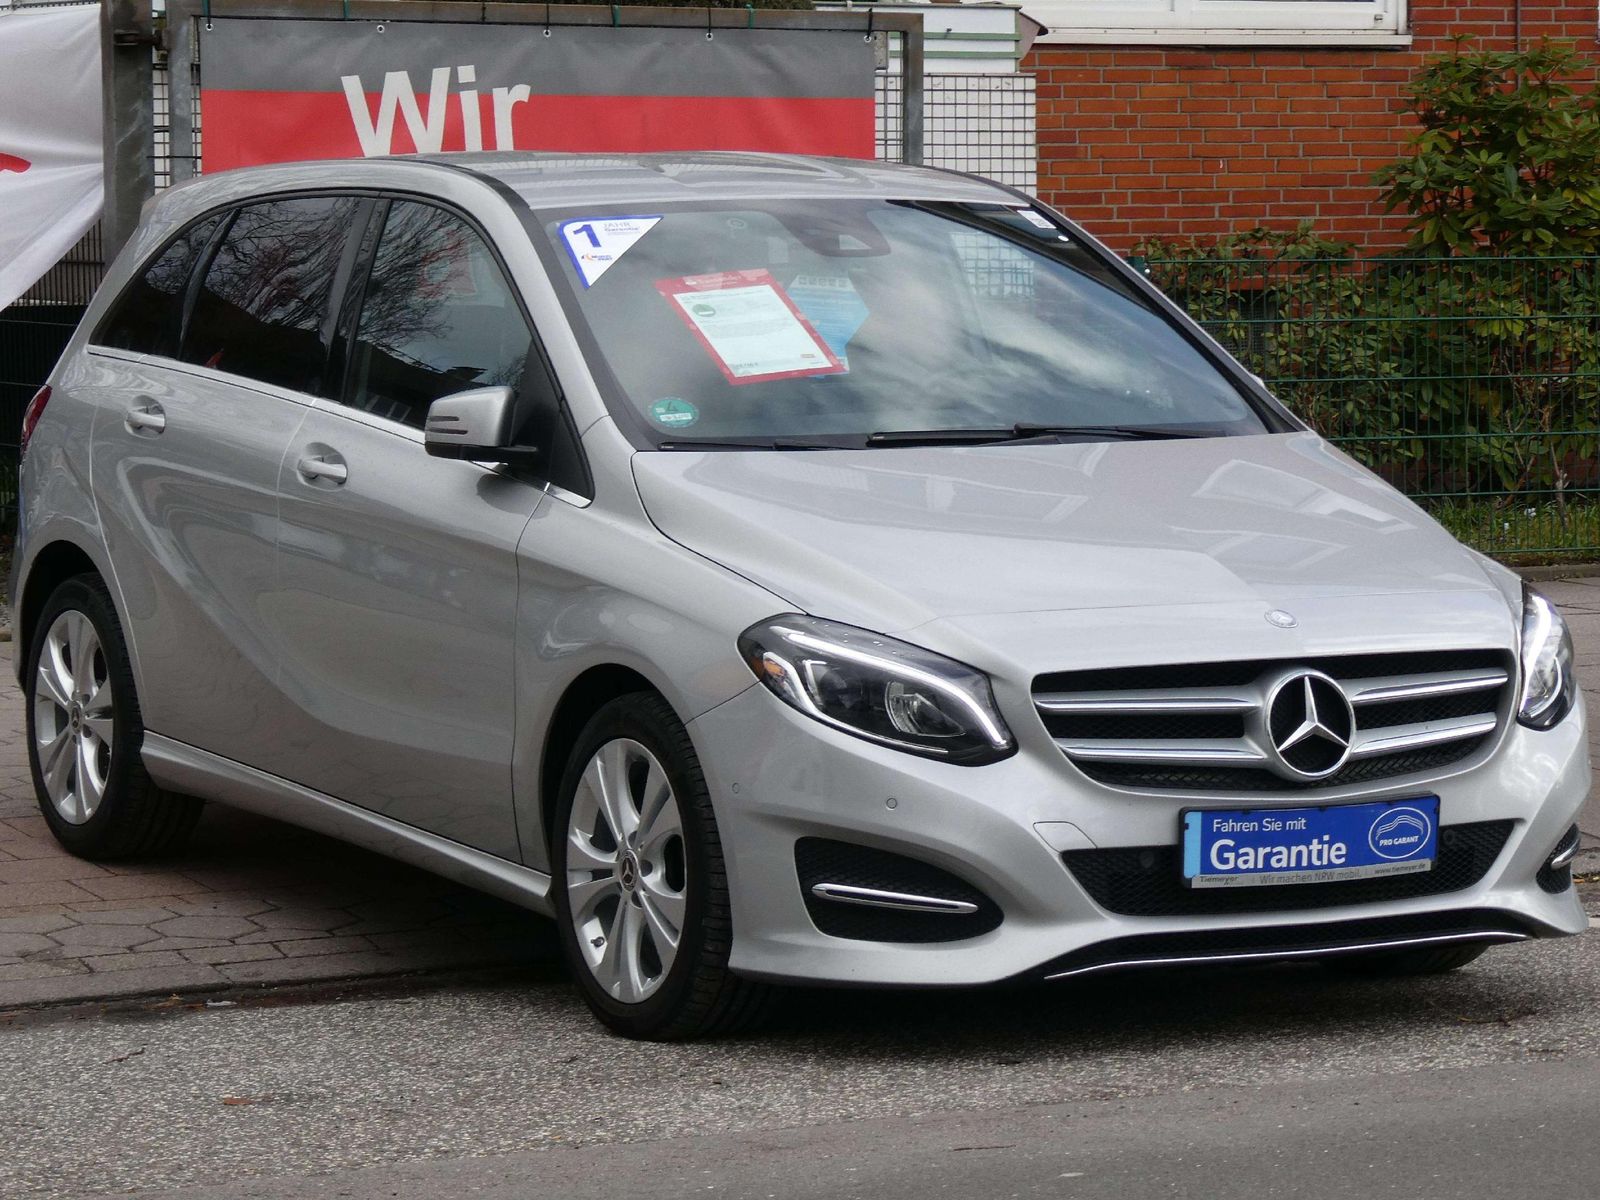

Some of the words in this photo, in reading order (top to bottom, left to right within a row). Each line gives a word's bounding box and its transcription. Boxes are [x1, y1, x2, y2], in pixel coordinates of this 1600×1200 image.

[341, 65, 531, 158] Wir
[573, 224, 602, 247] 1
[1213, 819, 1258, 832] Fahren
[1262, 818, 1282, 831] Sie
[1286, 817, 1307, 830] mit
[1393, 836, 1419, 845] GARANT
[1210, 835, 1347, 870] Garantie
[1200, 875, 1239, 886] Tiemeyer
[1260, 875, 1275, 884] Wir
[1276, 873, 1313, 883] machen
[1315, 871, 1335, 881] NRW
